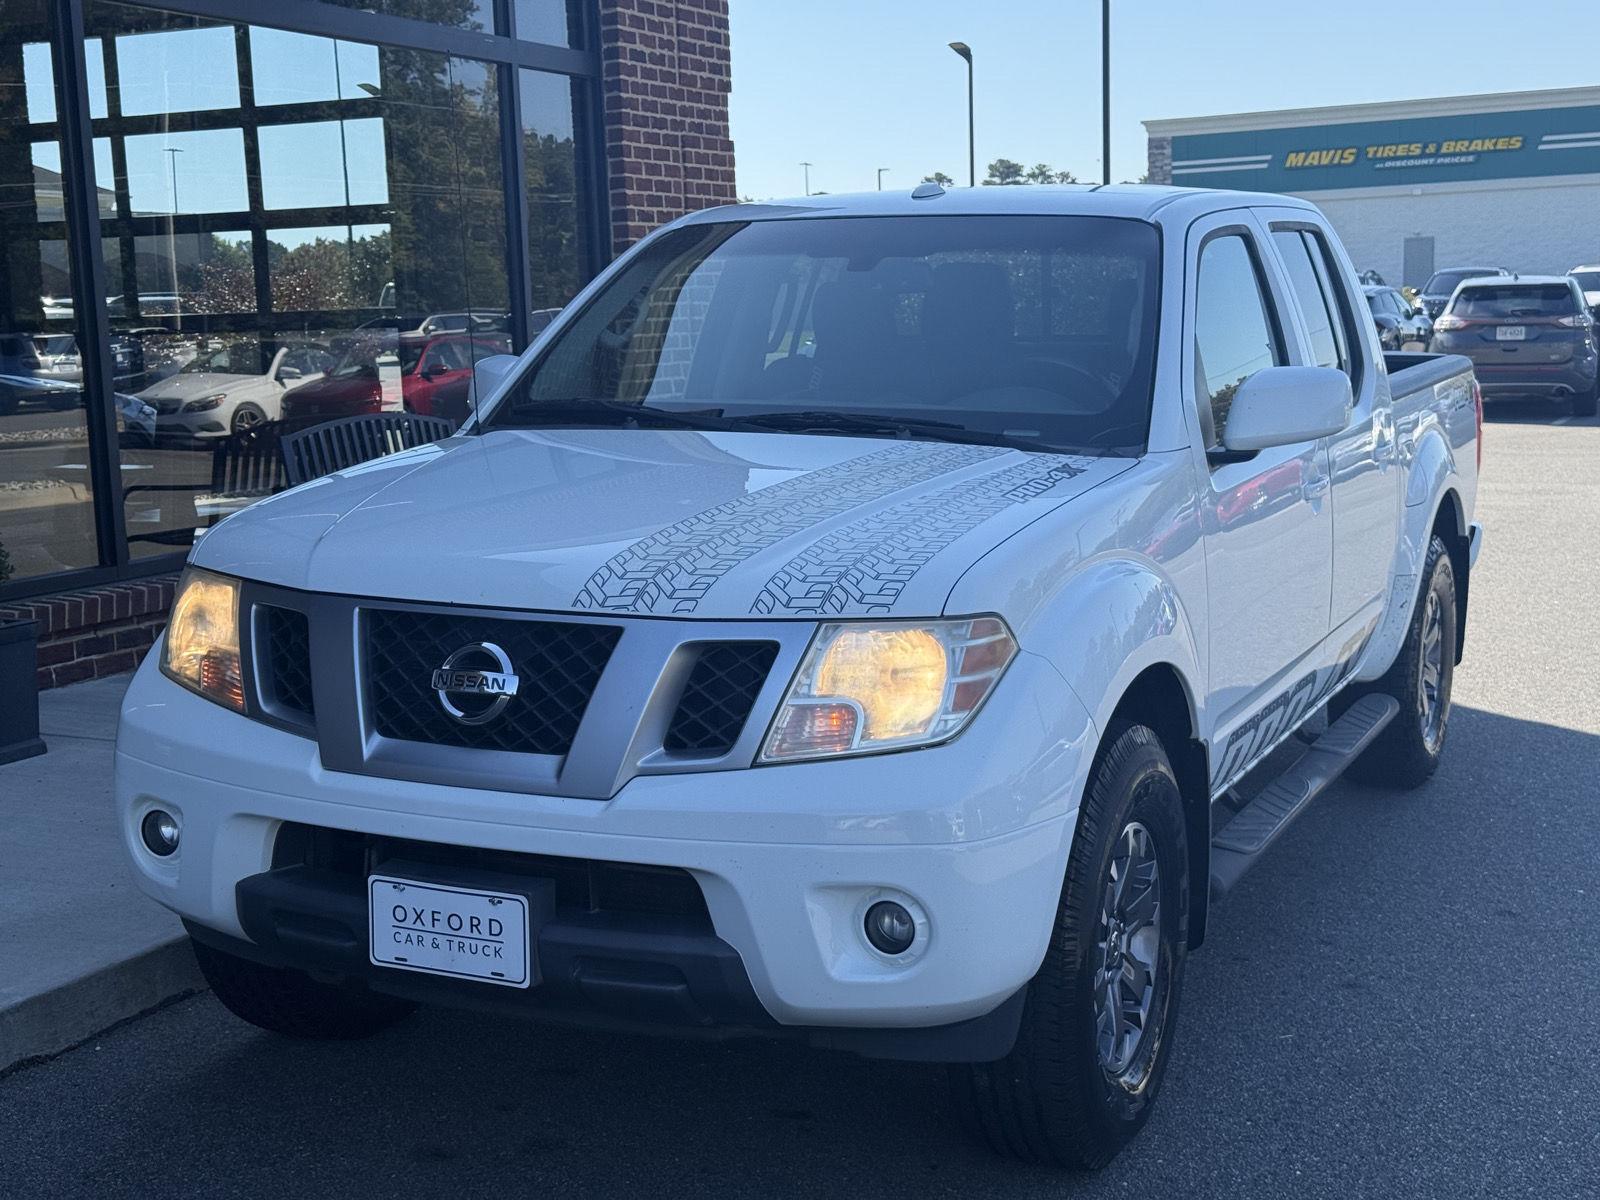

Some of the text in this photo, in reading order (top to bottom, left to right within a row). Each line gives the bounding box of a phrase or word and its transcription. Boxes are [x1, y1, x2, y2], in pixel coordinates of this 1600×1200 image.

[1285, 136, 1523, 168] MAVIS TIRES & BRAKES
[1384, 158, 1436, 168] DISCOUNT
[1437, 155, 1475, 165] PRICES
[1002, 463, 1088, 504] PRO-4X
[437, 672, 506, 691] NISSAN
[392, 904, 503, 937] OXFORD
[393, 931, 503, 959] CAR & TRUCK
